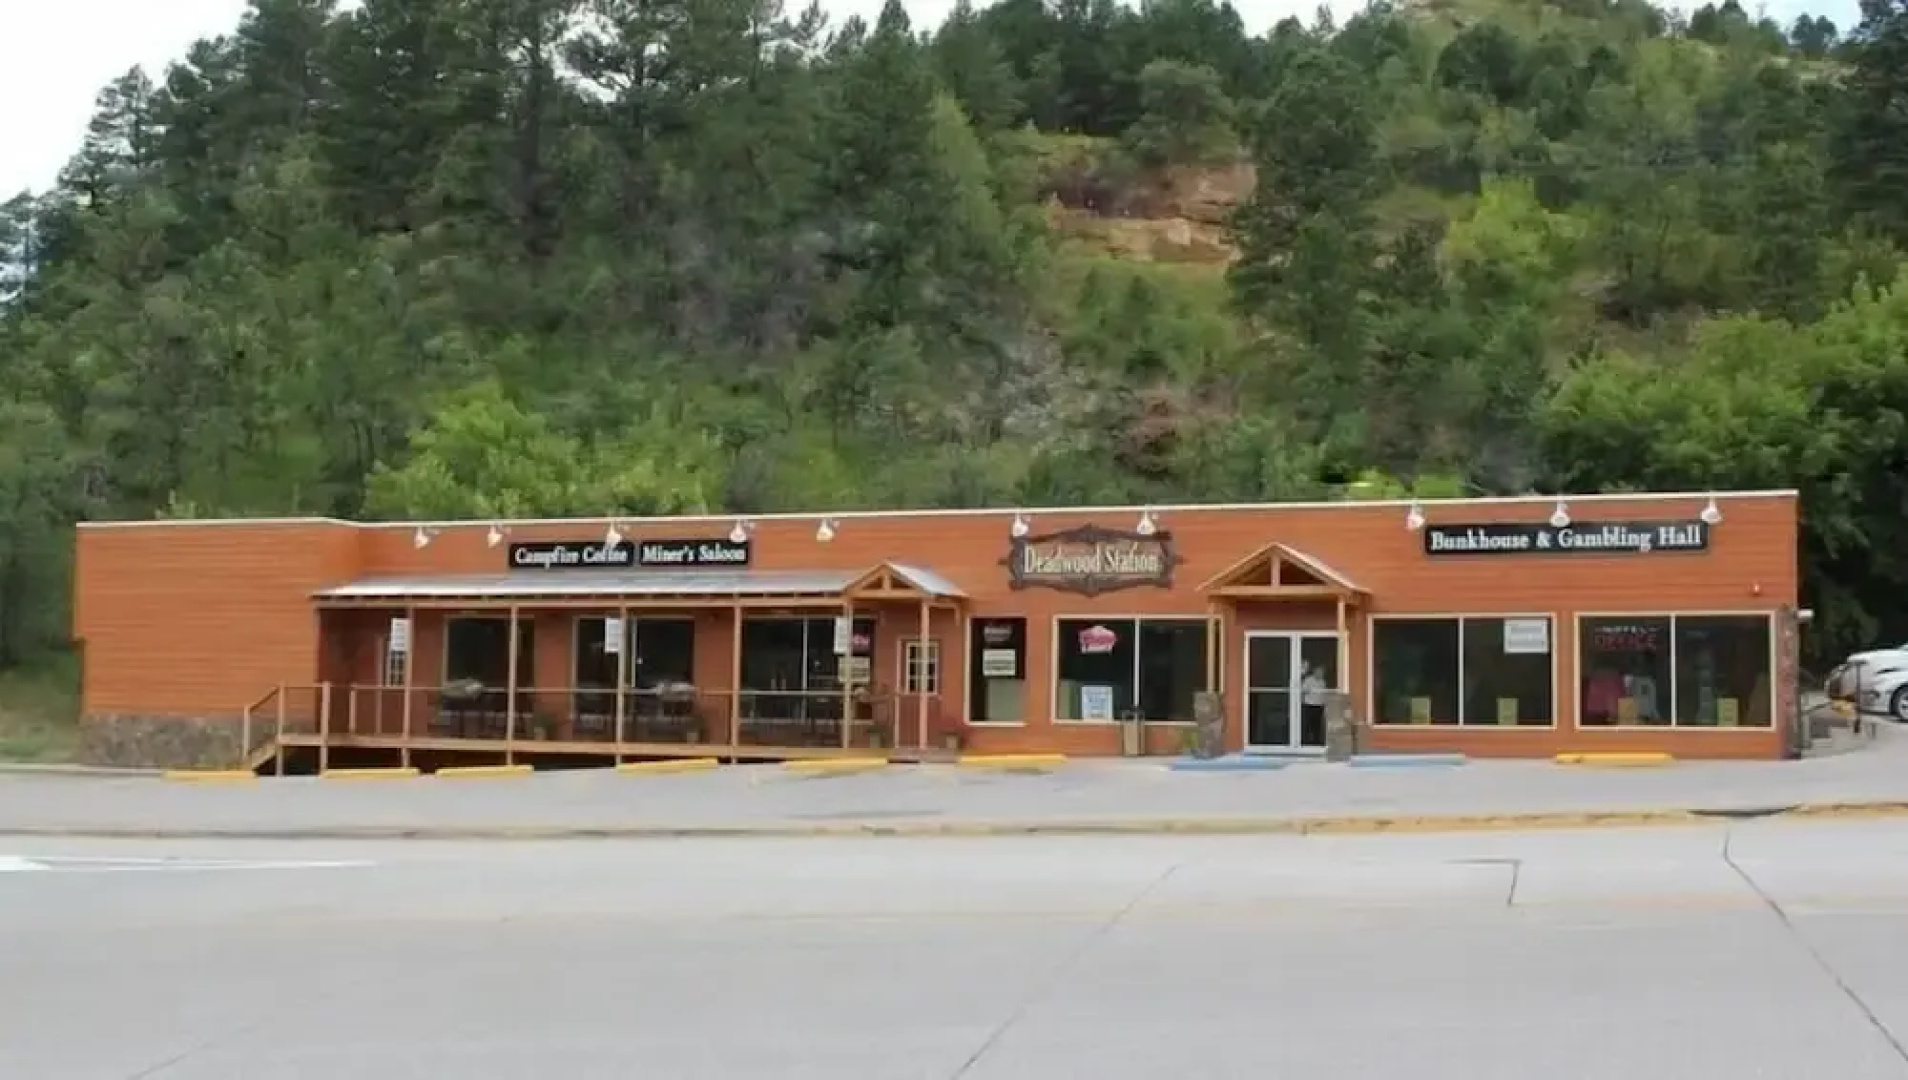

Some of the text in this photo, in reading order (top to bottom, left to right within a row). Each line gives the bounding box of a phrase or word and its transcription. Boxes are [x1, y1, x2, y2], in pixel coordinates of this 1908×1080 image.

[1431, 525, 1702, 552] Bunkhouse & Gambling Hall
[515, 546, 579, 571] Campfire
[642, 544, 746, 562] Miner's Saloon
[1024, 542, 1162, 574] Deadwood Station
